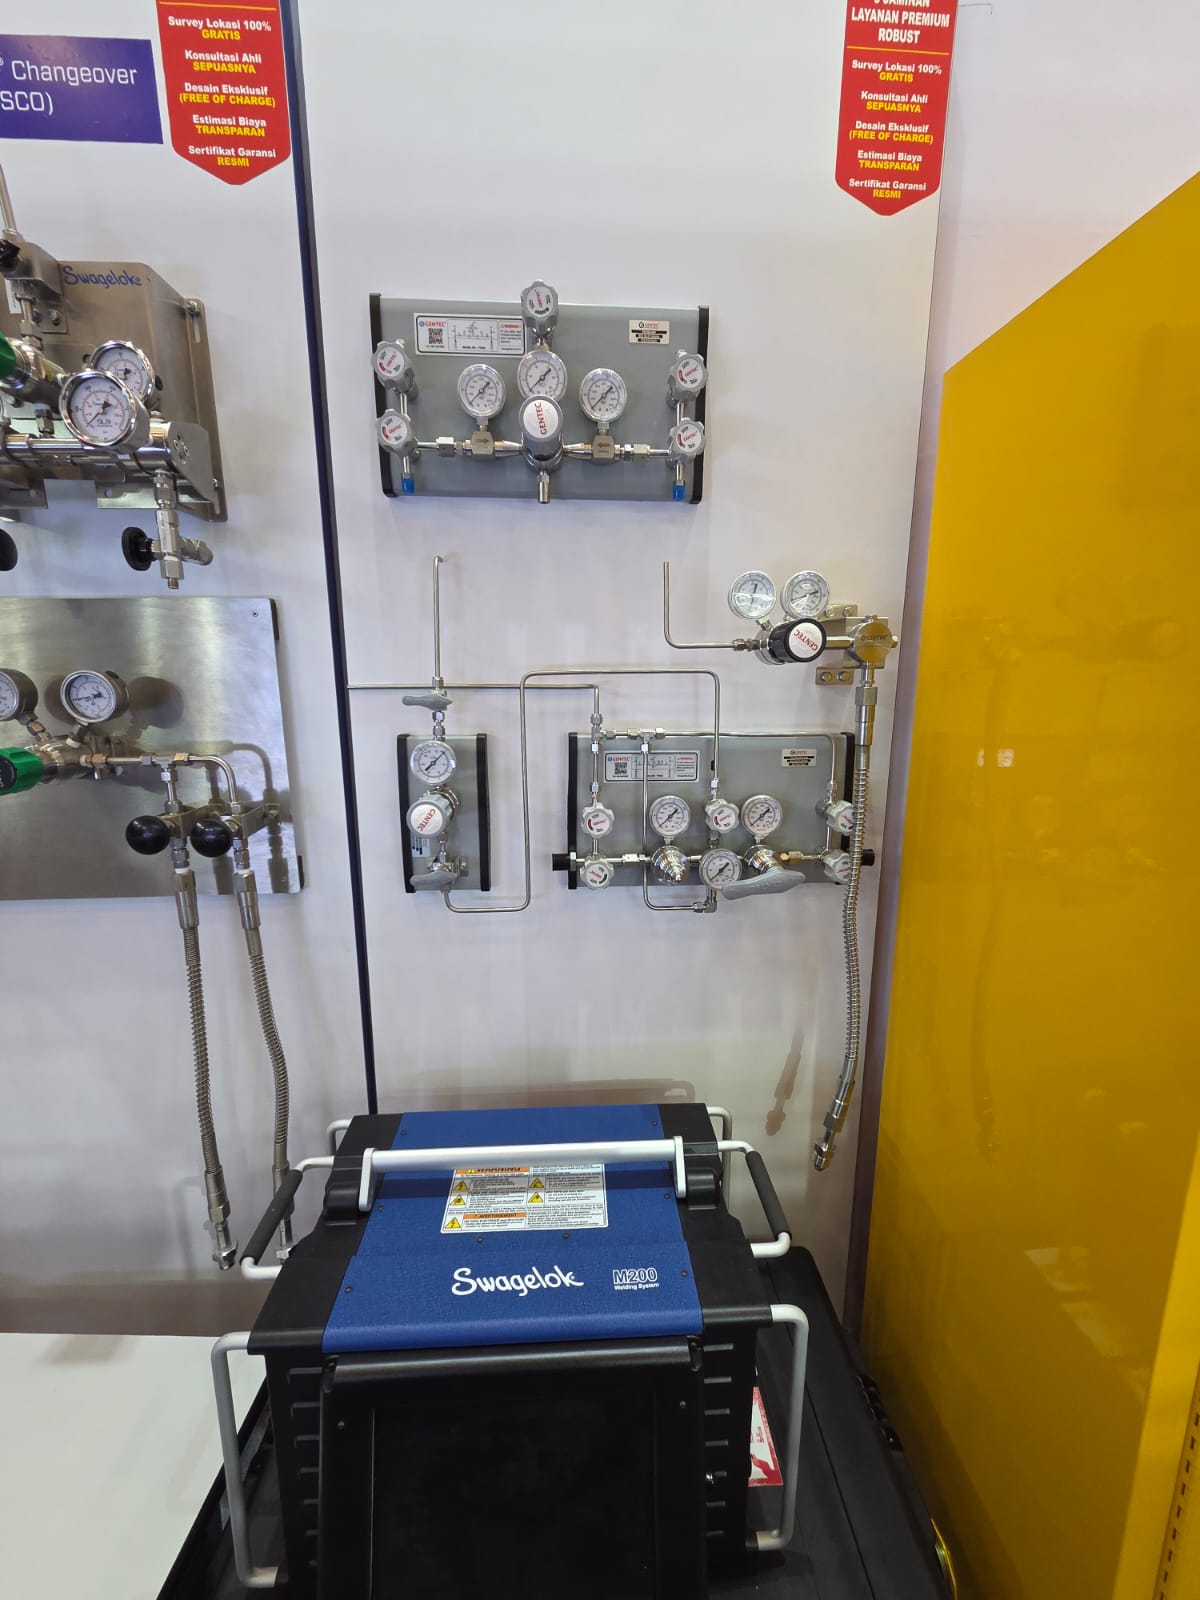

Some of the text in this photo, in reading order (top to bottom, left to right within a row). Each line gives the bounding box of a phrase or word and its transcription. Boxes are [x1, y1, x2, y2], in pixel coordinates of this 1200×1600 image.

[168, 16, 272, 32] Survey Lokasi 100%
[851, 7, 950, 28] LAYANAN PREMIUM
[201, 29, 241, 40] GRATIS
[878, 27, 921, 44] ROBUST
[184, 50, 262, 64] Konsultasi Ahli
[12, 60, 137, 86] Changeover
[193, 62, 256, 74] SEPUASNYA
[852, 60, 942, 75] Survey Lokasi 100%
[879, 72, 913, 83] GRATIS
[184, 82, 268, 96] Desain Eksklusif
[179, 93, 276, 108] (FREE OF CHARGE)
[861, 90, 928, 104] Konsultasi Ahli
[866, 101, 921, 113] SEPUASNYA
[192, 114, 267, 128] Estimasi Biaya
[855, 120, 929, 133] Desain Eksklusif
[195, 125, 265, 136] TRANSPARAN
[849, 130, 934, 145] (FREE OF CHARGE)
[188, 145, 276, 158] Sertifikat Garansi
[857, 150, 922, 163] Estimasi Biaya
[217, 157, 249, 167] RESMI
[859, 160, 920, 171] TRANSPARAN
[849, 178, 926, 191] Sertifikat Garansi
[873, 189, 901, 199] RESMI
[63, 265, 142, 288] Swagelok
[534, 402, 548, 435] GENTEC
[793, 629, 818, 651] GENTEC
[416, 808, 436, 832] GENTEC
[451, 1265, 584, 1296] Swagelok
[612, 1267, 658, 1284] M200
[638, 1282, 660, 1290] System
